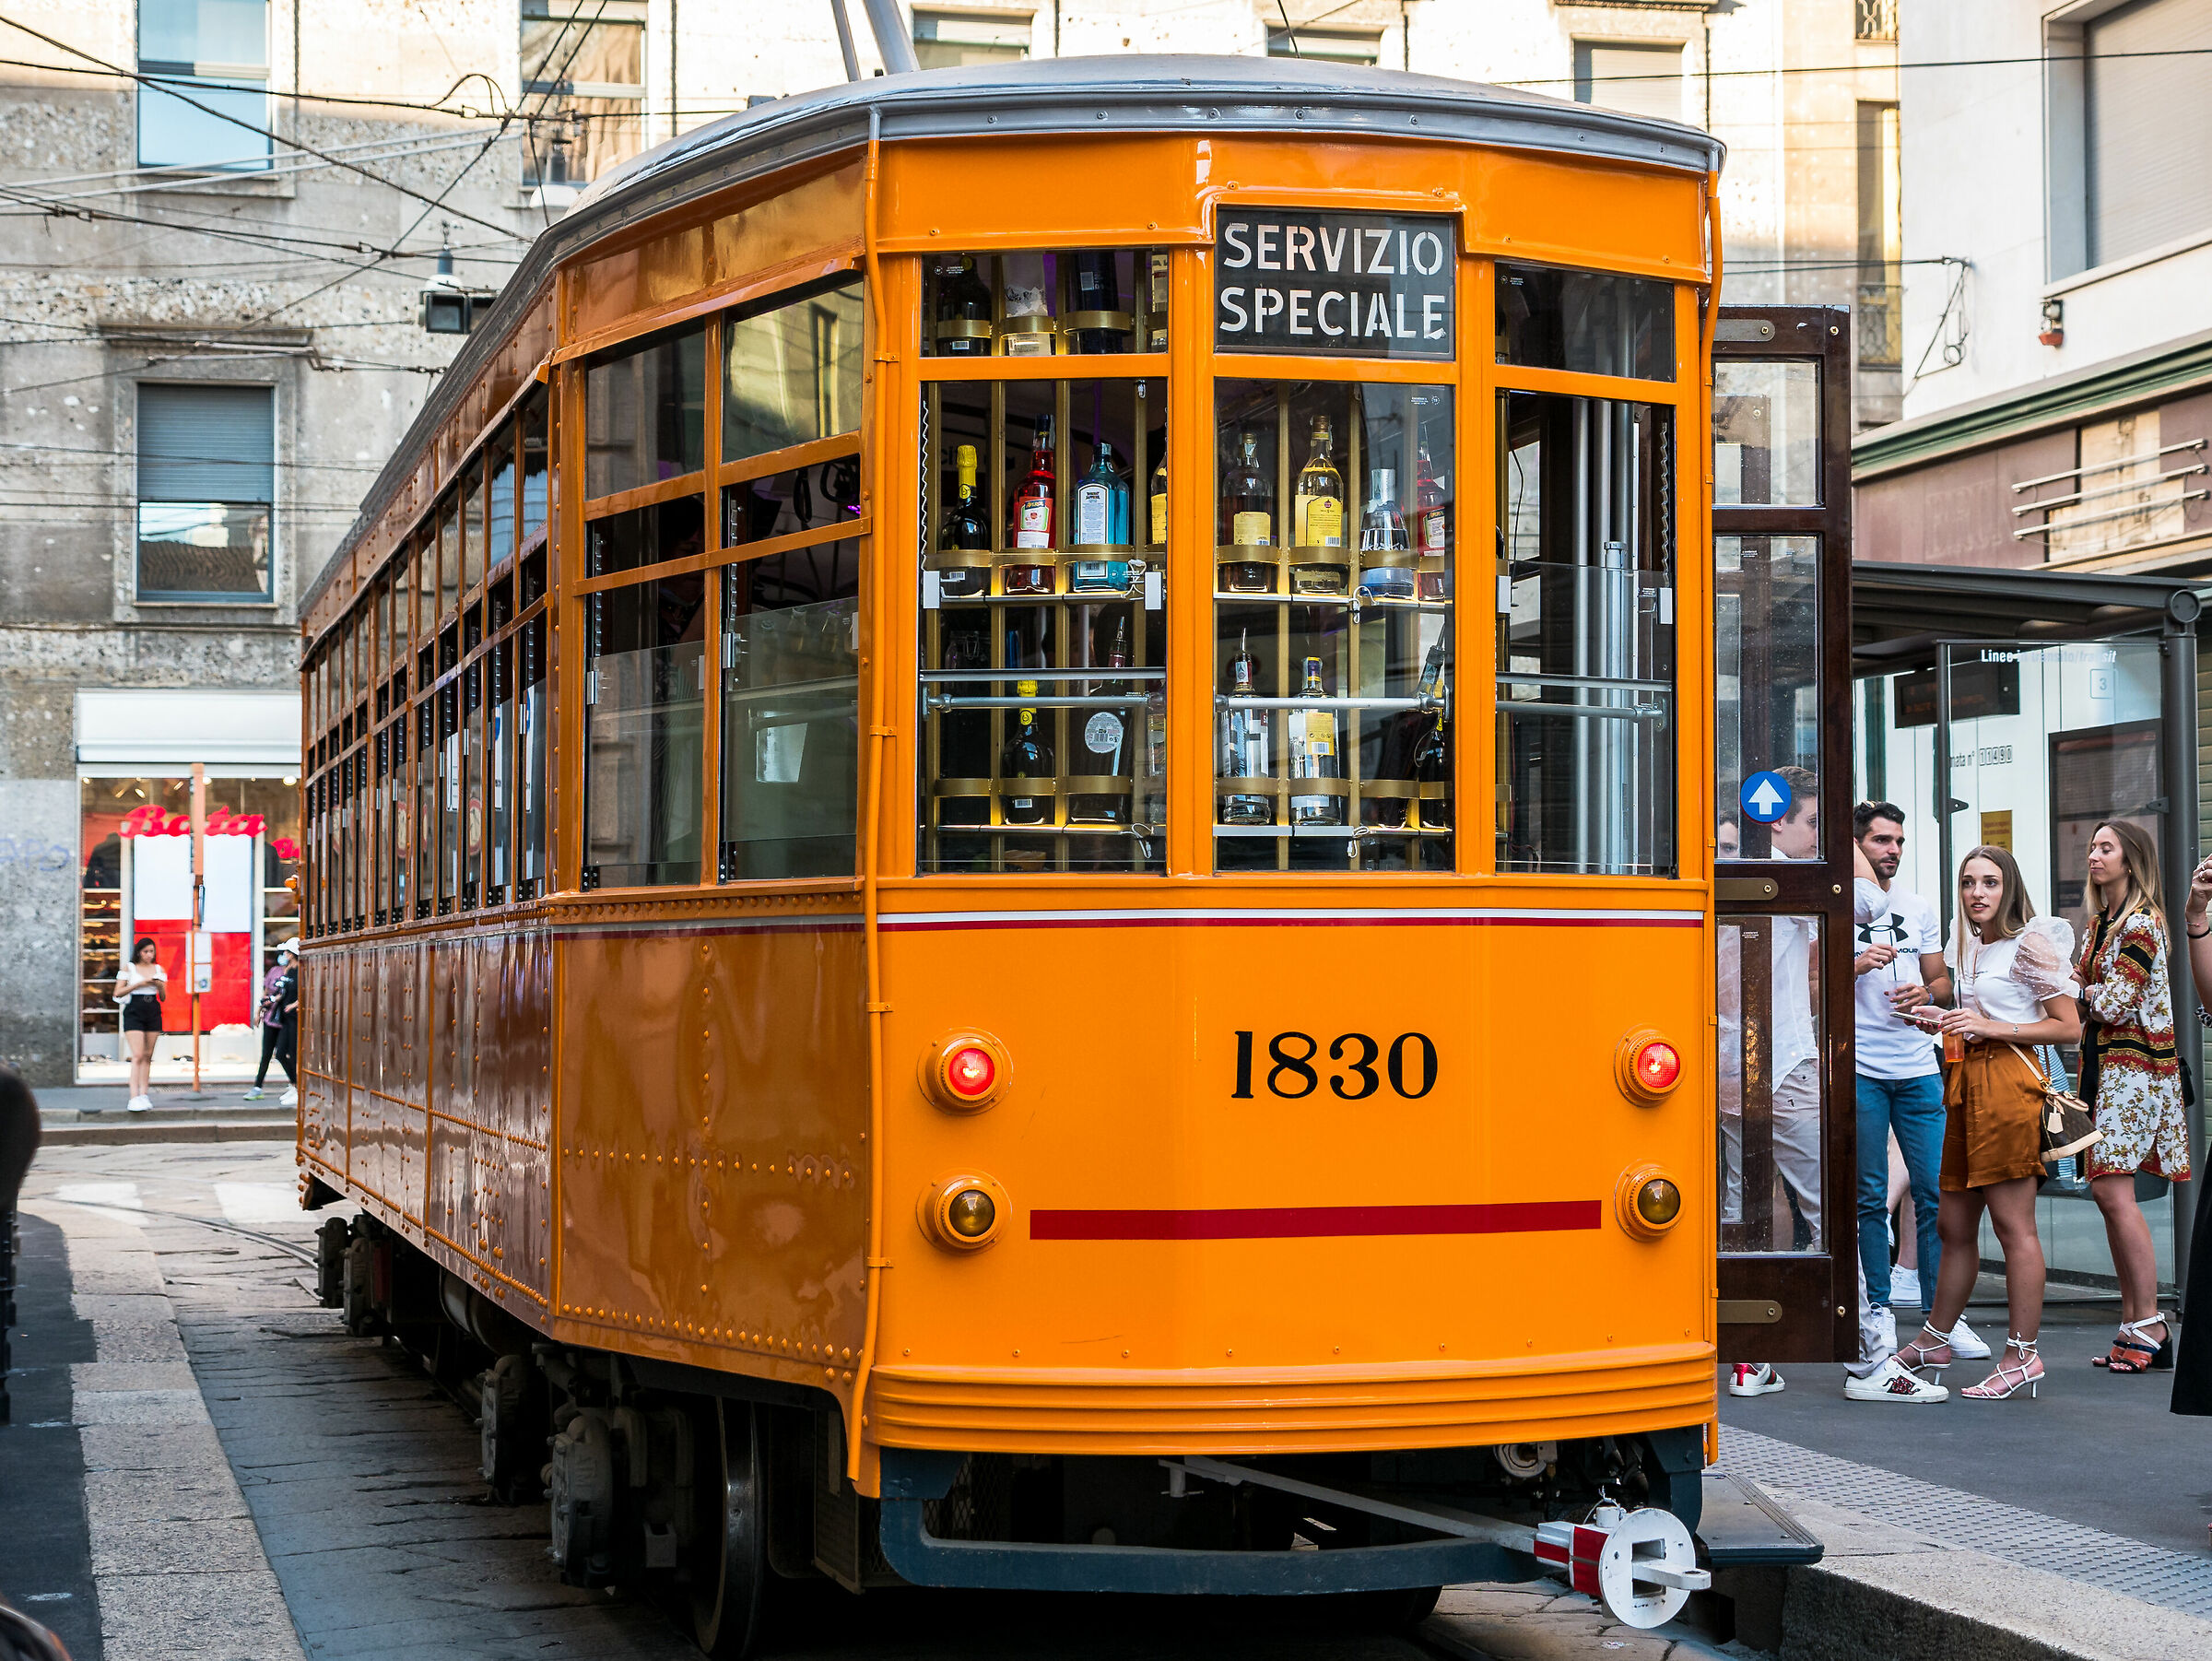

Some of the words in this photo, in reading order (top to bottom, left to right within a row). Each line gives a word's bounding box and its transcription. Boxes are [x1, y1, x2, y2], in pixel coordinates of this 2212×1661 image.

[1223, 224, 1443, 276] SERVIZIO
[1219, 287, 1446, 340] SPECIALE
[1981, 649, 2014, 663] Linee
[1231, 1031, 1438, 1100] 1830
